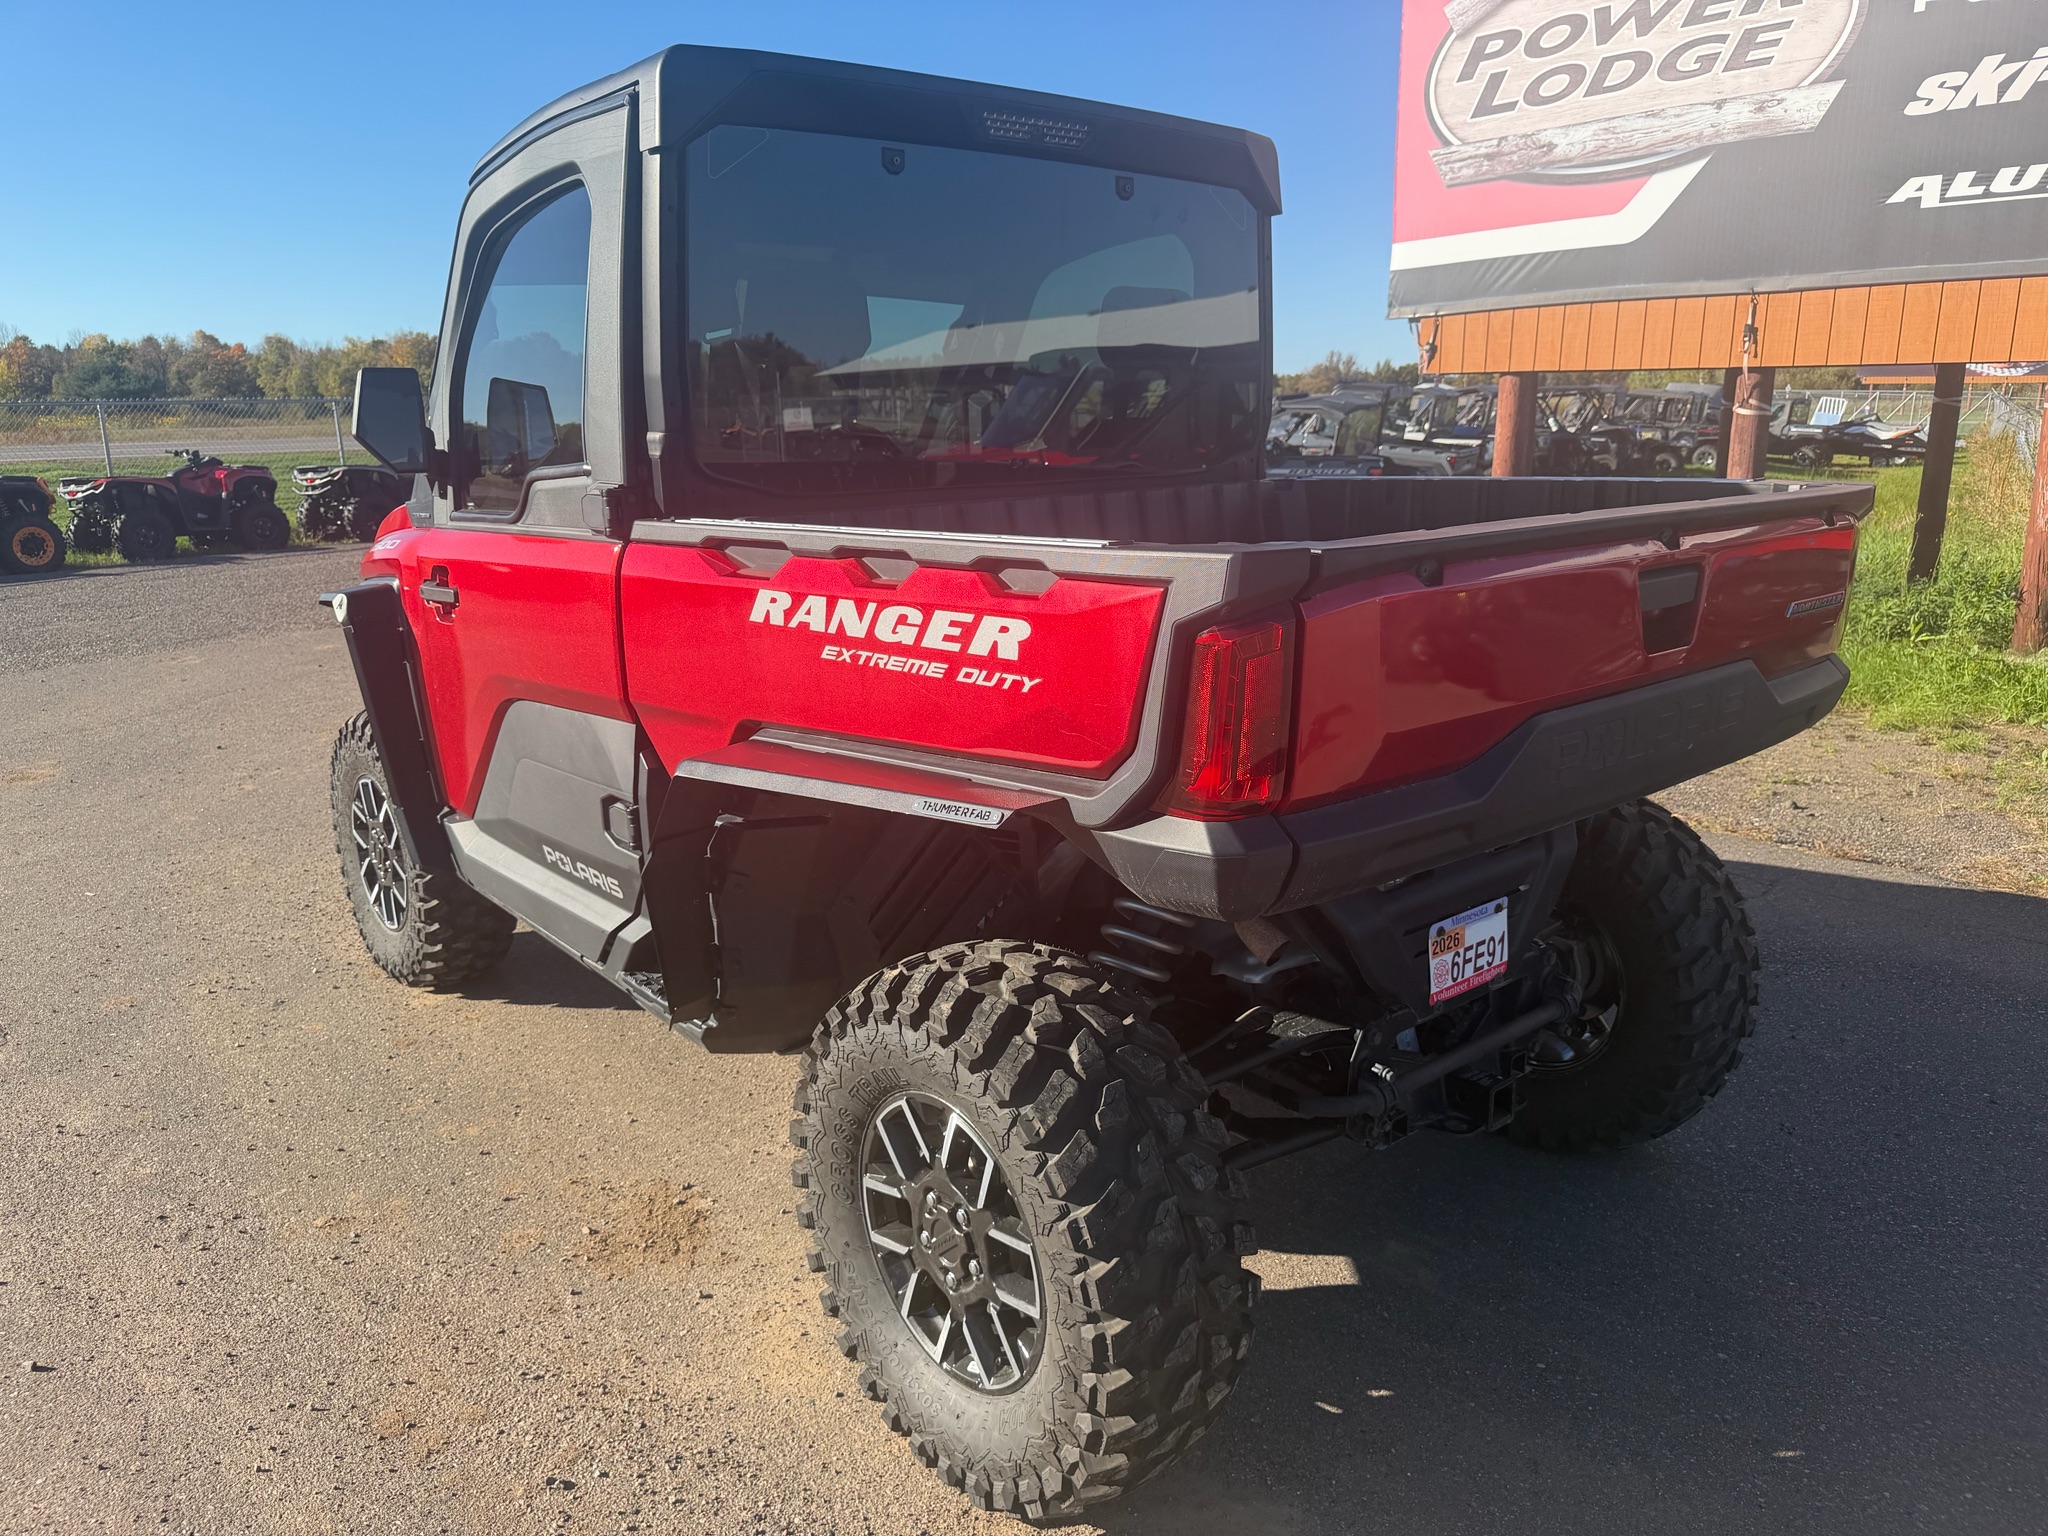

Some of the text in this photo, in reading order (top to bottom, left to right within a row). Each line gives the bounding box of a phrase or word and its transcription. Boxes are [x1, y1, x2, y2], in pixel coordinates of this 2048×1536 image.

[1469, 20, 1795, 119] LODGE
[1888, 163, 2048, 208] ALU
[749, 588, 1032, 661] RANGER
[1793, 595, 1842, 613] NORTHSTAR
[820, 645, 1043, 693] EXTREME DUTY
[542, 844, 624, 899] POLARIS
[1451, 906, 1488, 927] Minnesota
[1432, 932, 1460, 956] 2026
[1451, 930, 1506, 983] 6FE91
[1433, 965, 1505, 1002] Volunteer Firefighter
[830, 1067, 911, 1205] CROSS TRAIL
